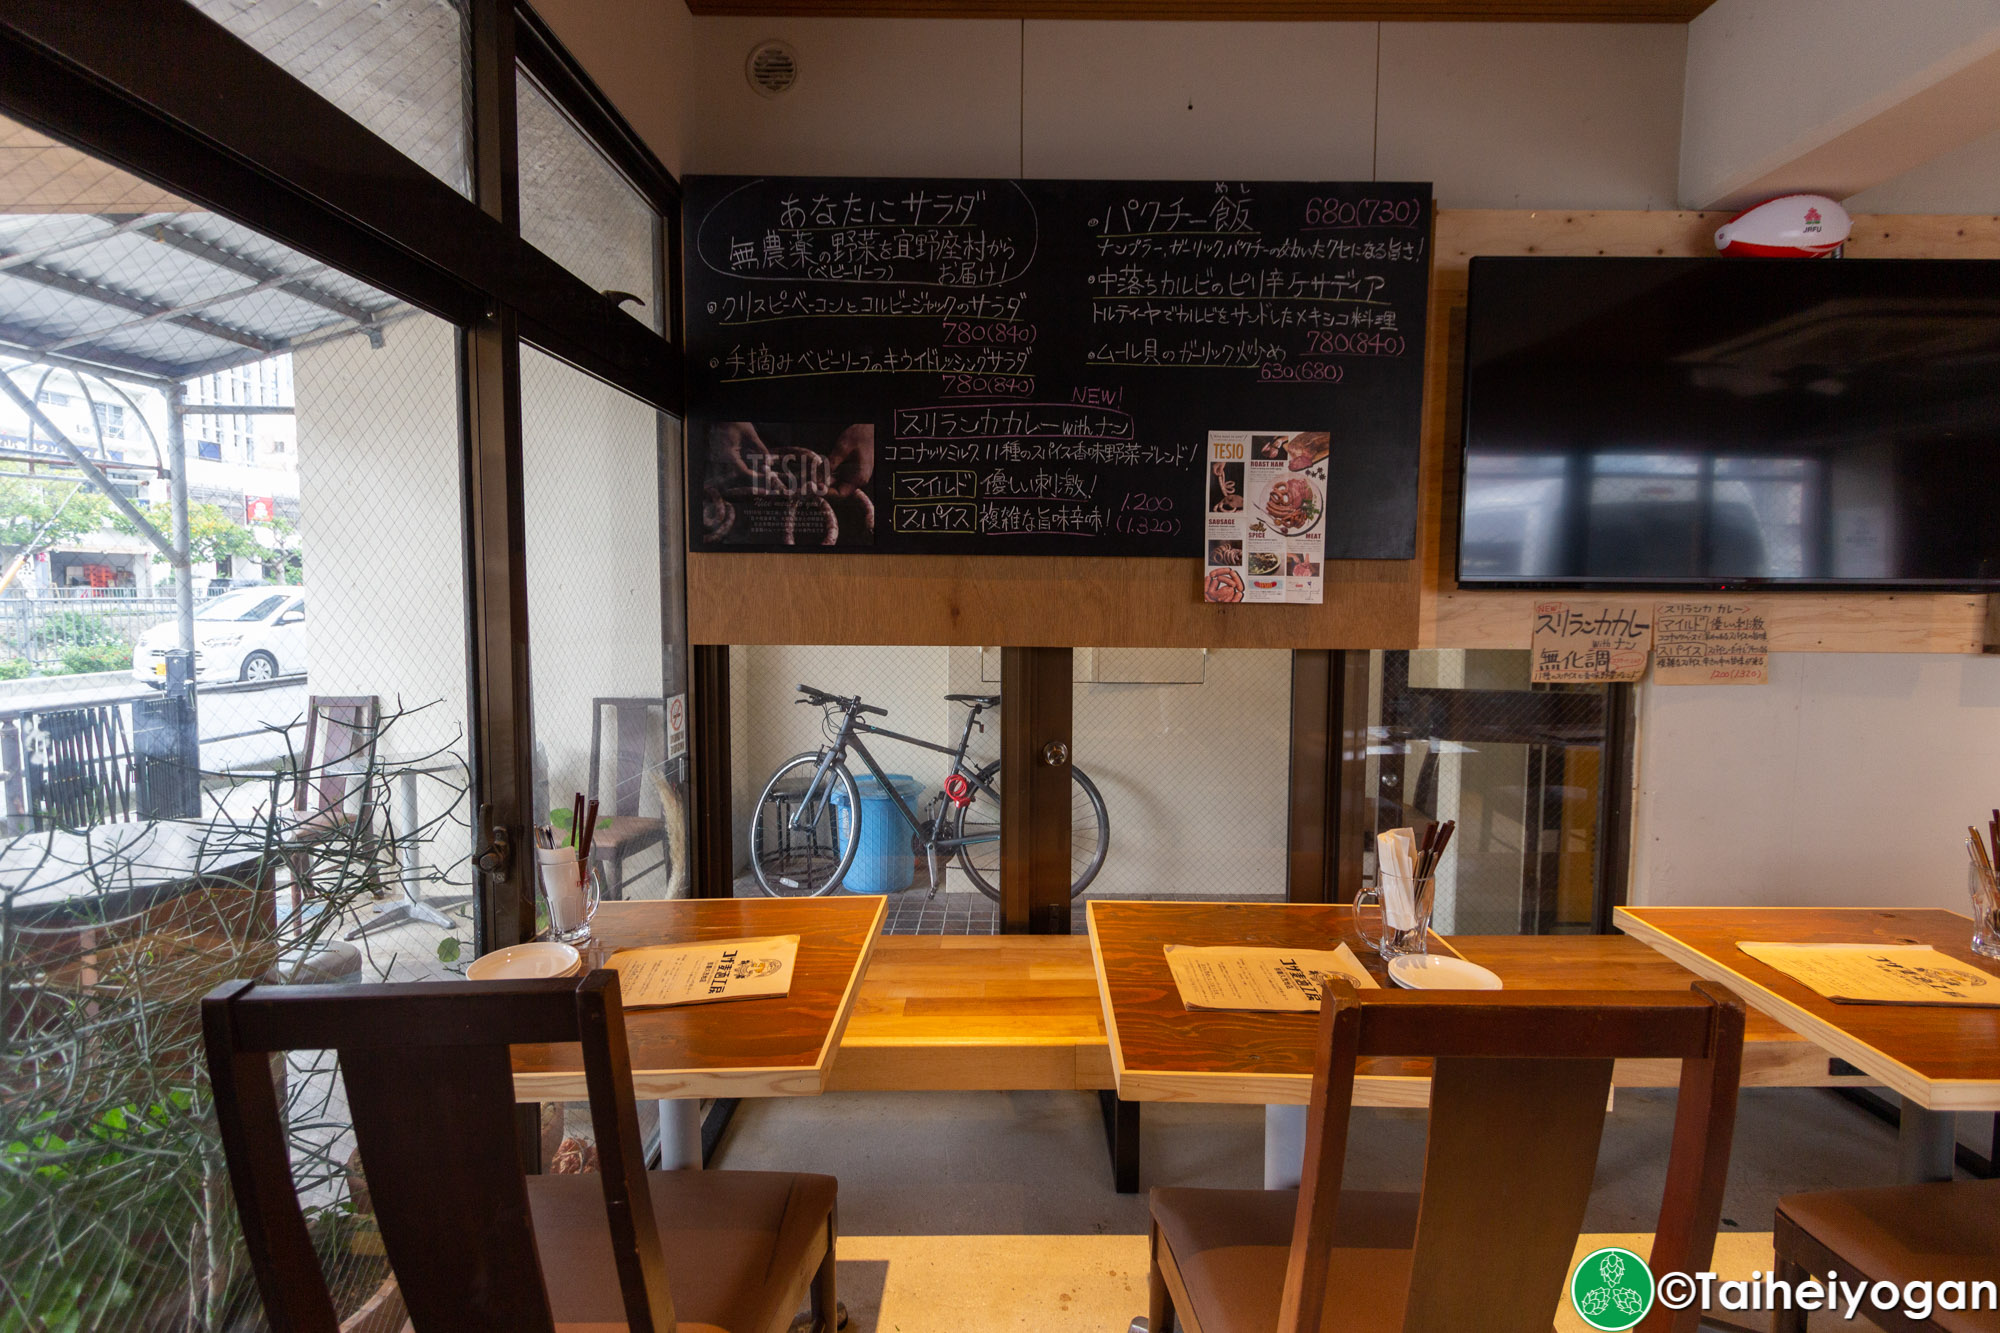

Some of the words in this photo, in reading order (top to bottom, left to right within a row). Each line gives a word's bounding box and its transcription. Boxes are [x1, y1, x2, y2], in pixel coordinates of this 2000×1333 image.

[780, 190, 986, 228] あなたにサラダ
[1104, 196, 1254, 232] パクチー飯
[1305, 198, 1421, 226] 680(730)
[1803, 226, 1822, 234] JRFU
[941, 321, 1037, 345] 780(840)
[1306, 330, 1406, 355] 780(840)
[1261, 362, 1344, 381] 630(680)
[941, 373, 1036, 395] 780(840)
[1071, 385, 1124, 410] NEW!
[1213, 443, 1244, 459] TESIO
[746, 453, 831, 496] TESIO
[901, 473, 972, 497] マイルド
[901, 505, 971, 529] スパイス
[1536, 608, 1650, 638] スリランカカレー
[1660, 616, 1705, 630] マイルド
[1613, 638, 1637, 650] ナン
[1658, 644, 1702, 655] スパイス
[1539, 648, 1611, 673] 無化調
